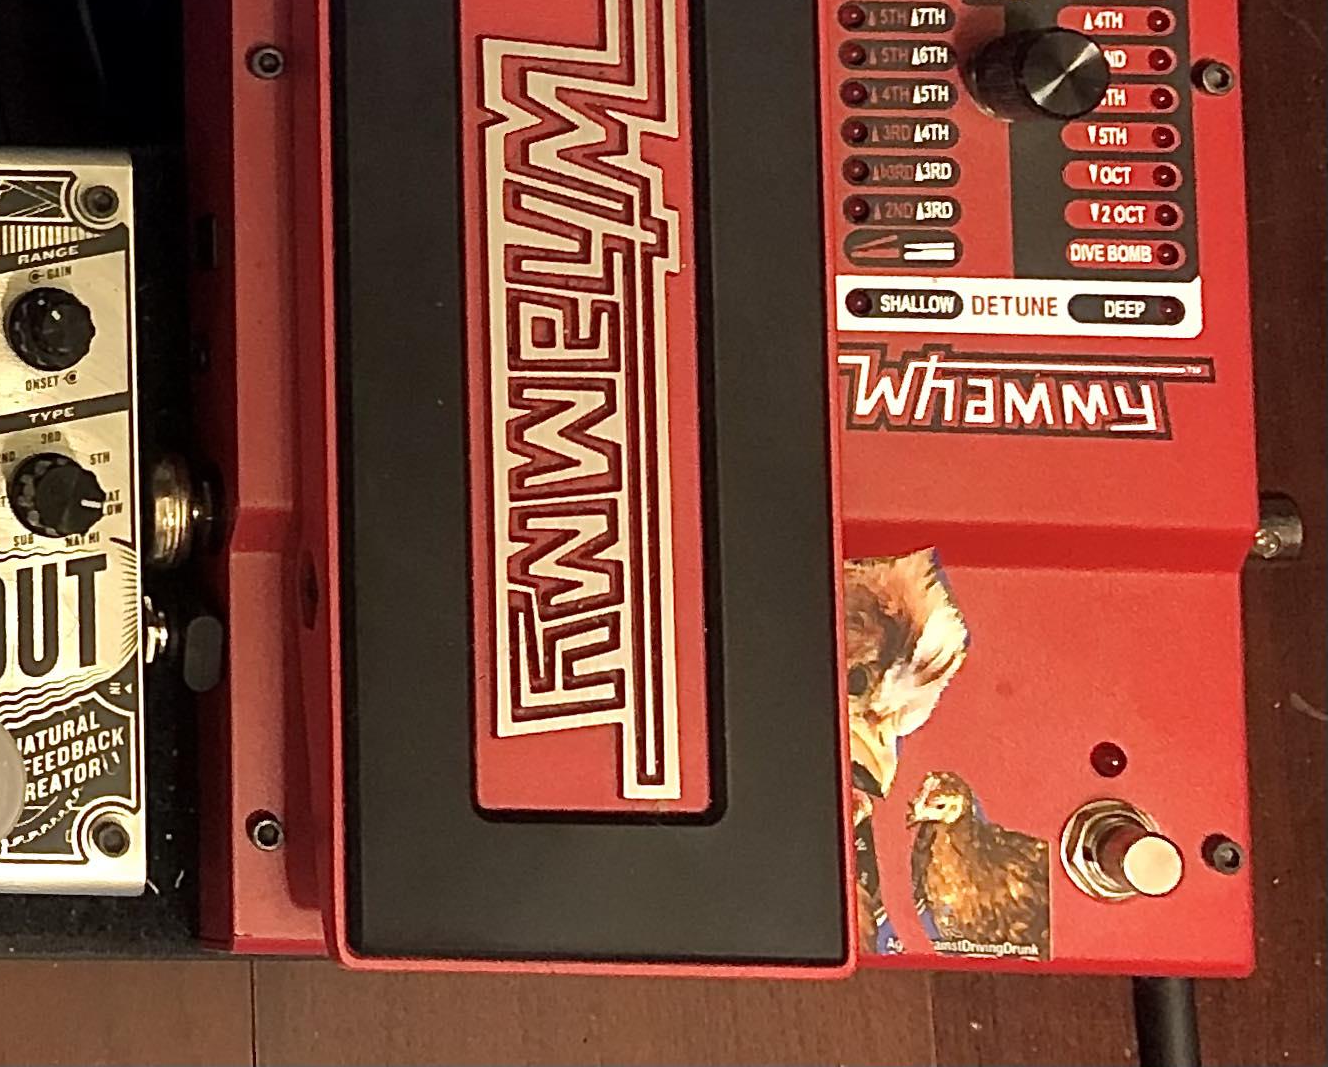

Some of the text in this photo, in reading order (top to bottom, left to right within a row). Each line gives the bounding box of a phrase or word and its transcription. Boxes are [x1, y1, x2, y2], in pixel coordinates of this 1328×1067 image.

[1095, 11, 1124, 29] 4TH
[921, 85, 949, 103] 5TH
[921, 124, 949, 142] 4TH
[1099, 126, 1127, 145] 5TH
[923, 163, 951, 180] 3RD
[1101, 166, 1131, 184] OCT
[925, 202, 953, 220] 3RD
[1101, 206, 1146, 224] 2 OCT
[17, 246, 80, 264] RANGE
[1070, 244, 1152, 263] DIVE BOMB
[881, 296, 1145, 318] SHALLOW DETUNE DEEP
[28, 407, 75, 423] TYPE
